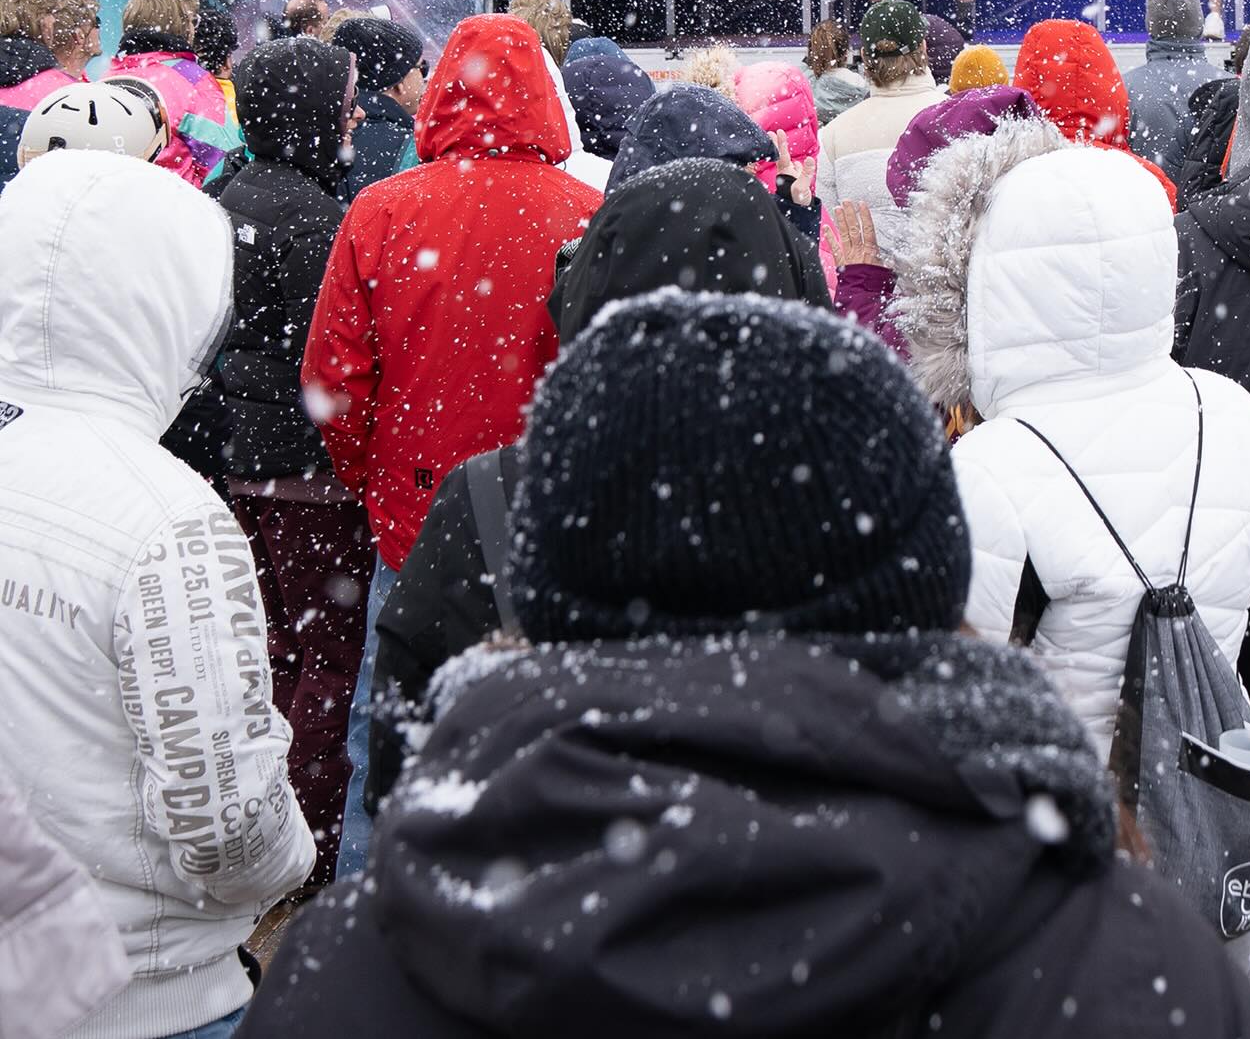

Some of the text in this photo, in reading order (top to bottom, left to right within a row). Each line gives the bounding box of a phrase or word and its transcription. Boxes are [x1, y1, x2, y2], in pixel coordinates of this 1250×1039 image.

[138, 573, 168, 629] GREEN
[181, 564, 215, 624] 25.01
[208, 512, 258, 637] DAVID
[147, 635, 176, 684] DEPT.
[194, 657, 207, 682] EDT
[154, 686, 206, 779] CAMP
[211, 730, 240, 802] SUPREME
[162, 781, 221, 876] DAVID
